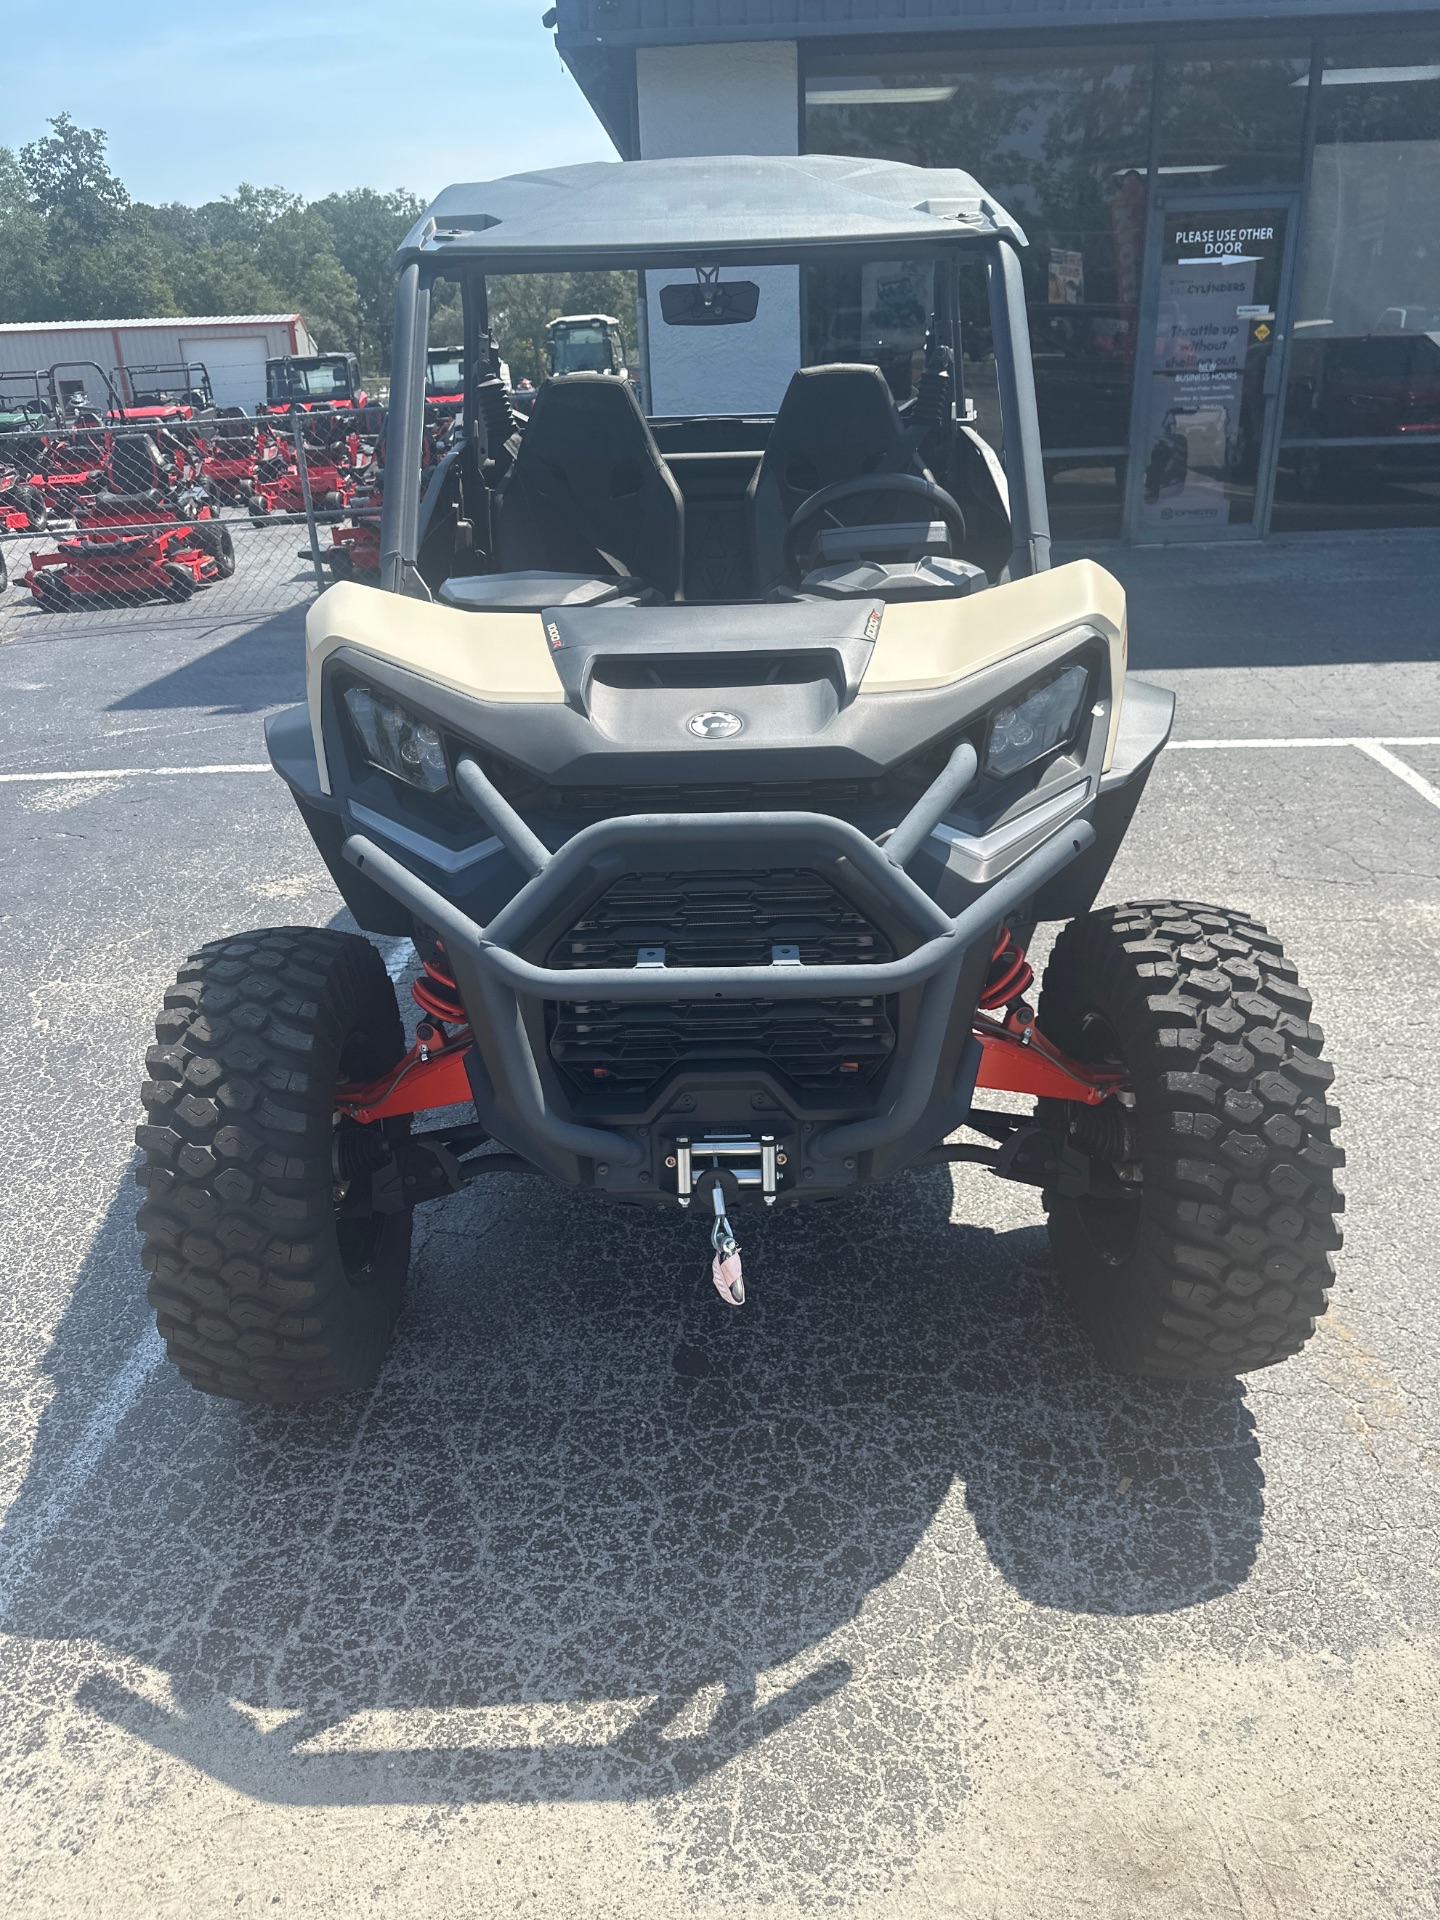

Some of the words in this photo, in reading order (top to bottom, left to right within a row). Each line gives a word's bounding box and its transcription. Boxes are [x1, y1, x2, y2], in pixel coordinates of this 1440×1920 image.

[1176, 231, 1214, 243] PLEASE
[1216, 230, 1236, 241] USE
[1239, 228, 1273, 240] OTHER
[1204, 242, 1242, 254] DOOR
[1171, 324, 1218, 337] Throttle
[1222, 326, 1239, 336] up
[1180, 340, 1227, 352] without
[1175, 374, 1210, 382] BUSINESS
[1211, 372, 1237, 381] HOURS
[866, 611, 881, 639] 1000R
[547, 622, 562, 649] 1000R
